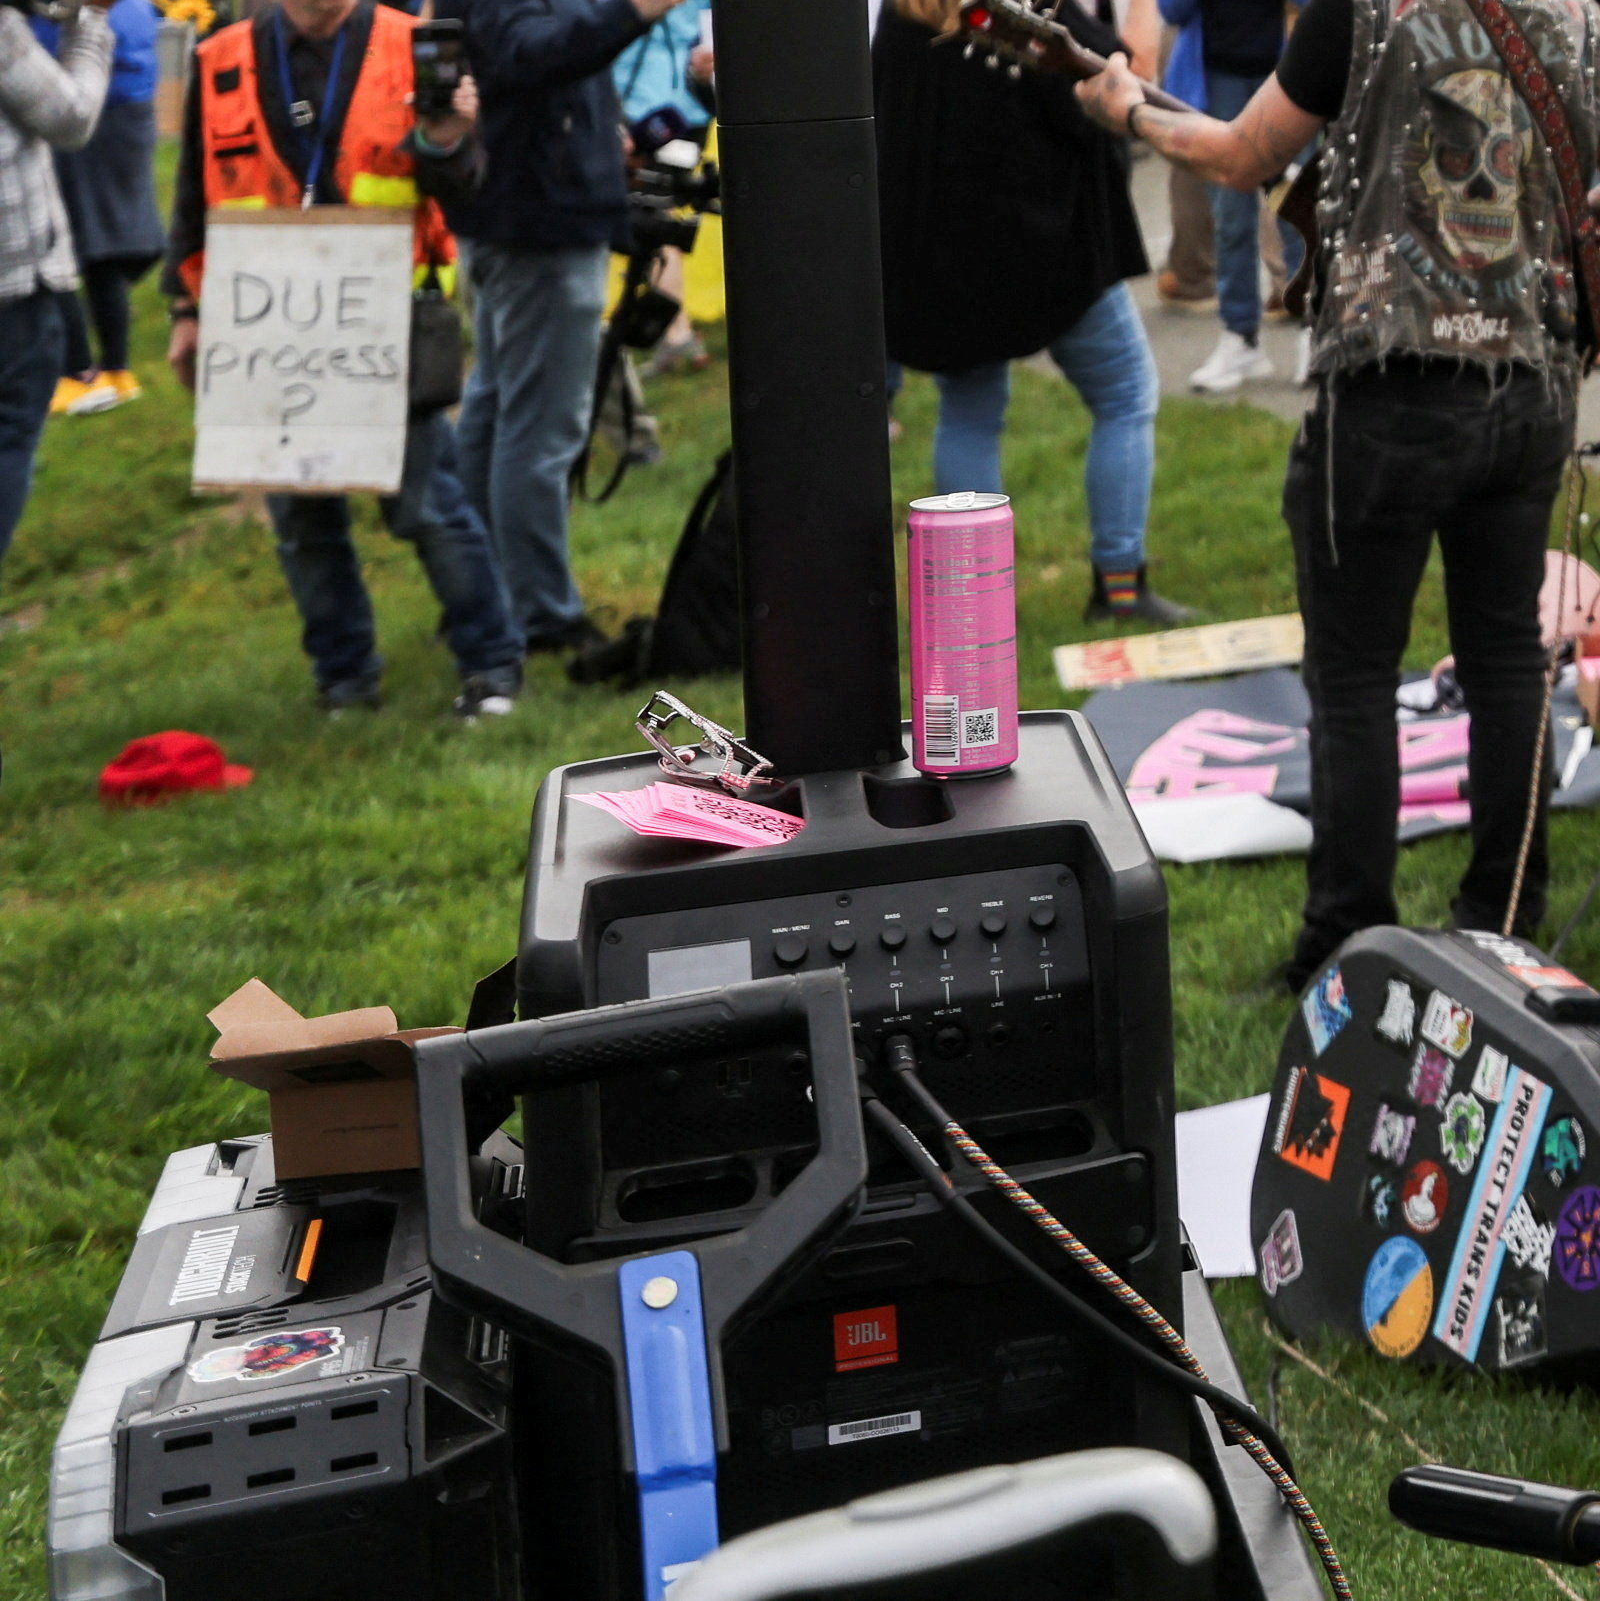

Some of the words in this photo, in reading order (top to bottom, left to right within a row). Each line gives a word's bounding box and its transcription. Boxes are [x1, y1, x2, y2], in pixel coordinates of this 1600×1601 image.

[231, 270, 376, 329] DUE
[203, 339, 401, 394] process
[1492, 1081, 1536, 1193] PROTECT
[1466, 1200, 1501, 1283] TRANS
[846, 1320, 887, 1347] JBL
[1450, 1285, 1477, 1341] KIDS
